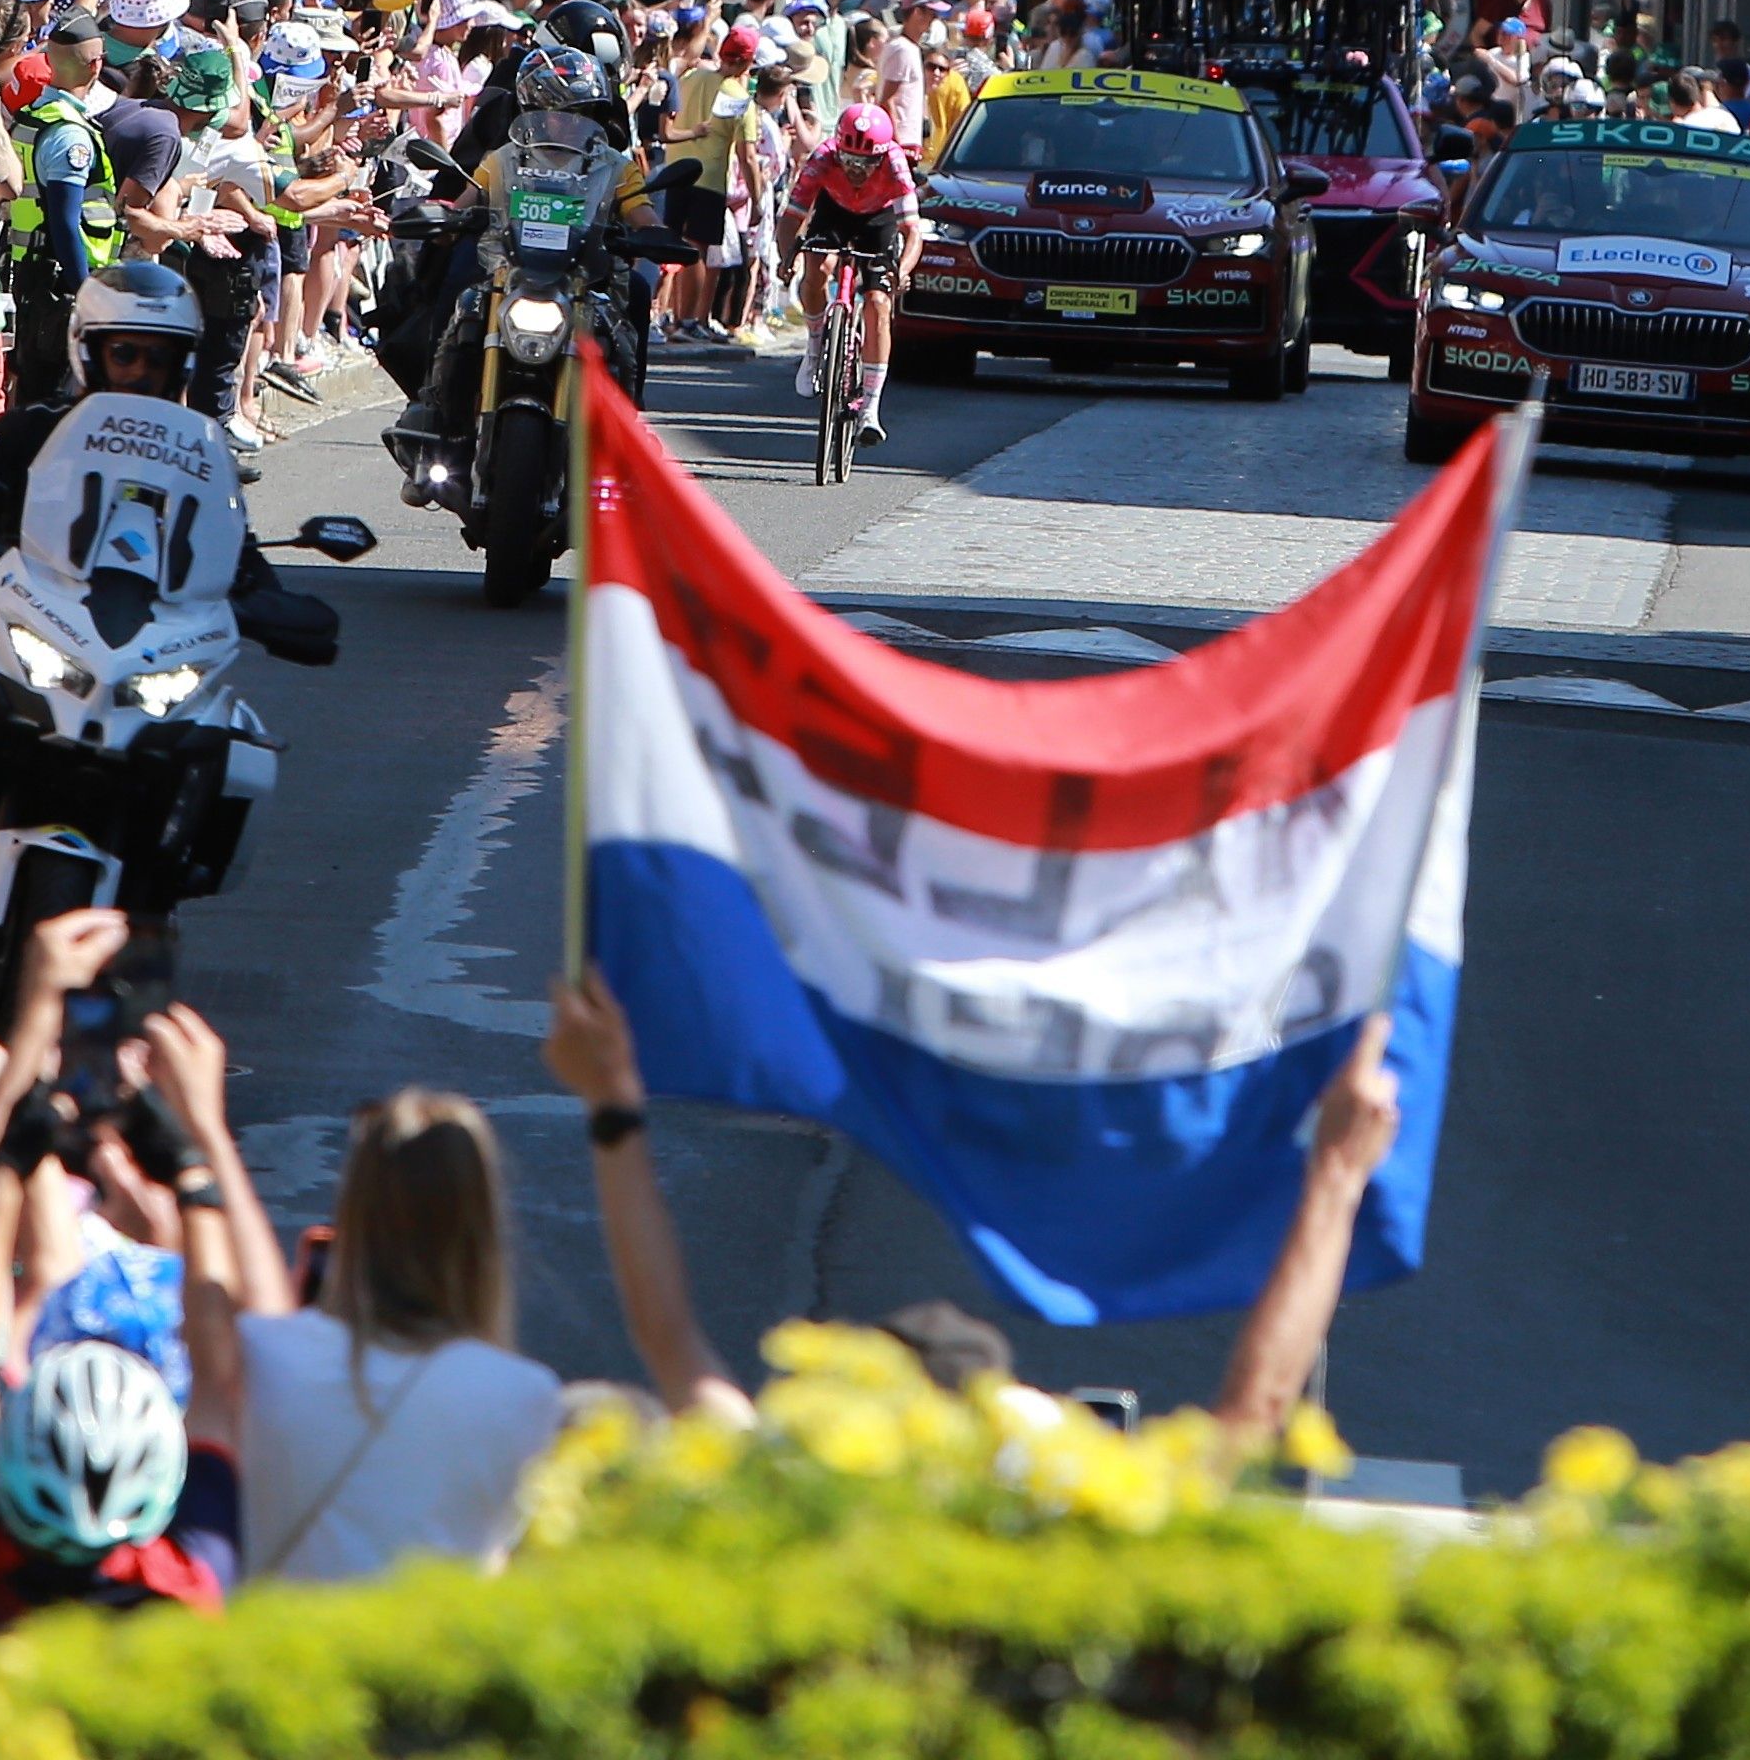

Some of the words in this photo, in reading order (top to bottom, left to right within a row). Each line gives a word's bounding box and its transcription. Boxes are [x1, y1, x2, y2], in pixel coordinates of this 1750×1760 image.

[1017, 75, 1051, 86] LCL
[1071, 71, 1157, 94] LCL
[1179, 82, 1210, 95] LCL
[517, 166, 589, 182] RUDY
[1038, 179, 1108, 197] france
[523, 194, 553, 204] PRESSE
[518, 202, 552, 221] 508
[523, 231, 543, 242] epa
[1570, 247, 1682, 268] E.Leclerc
[1213, 270, 1251, 281] HYBRID
[1048, 298, 1111, 311] GÉNÉRALE
[1049, 289, 1111, 301] DIRECTION
[1118, 292, 1132, 310] 1
[1446, 323, 1489, 340] HYBRID
[99, 414, 167, 441] AG2R
[175, 436, 207, 458] LA
[84, 433, 214, 483] MONDIALE
